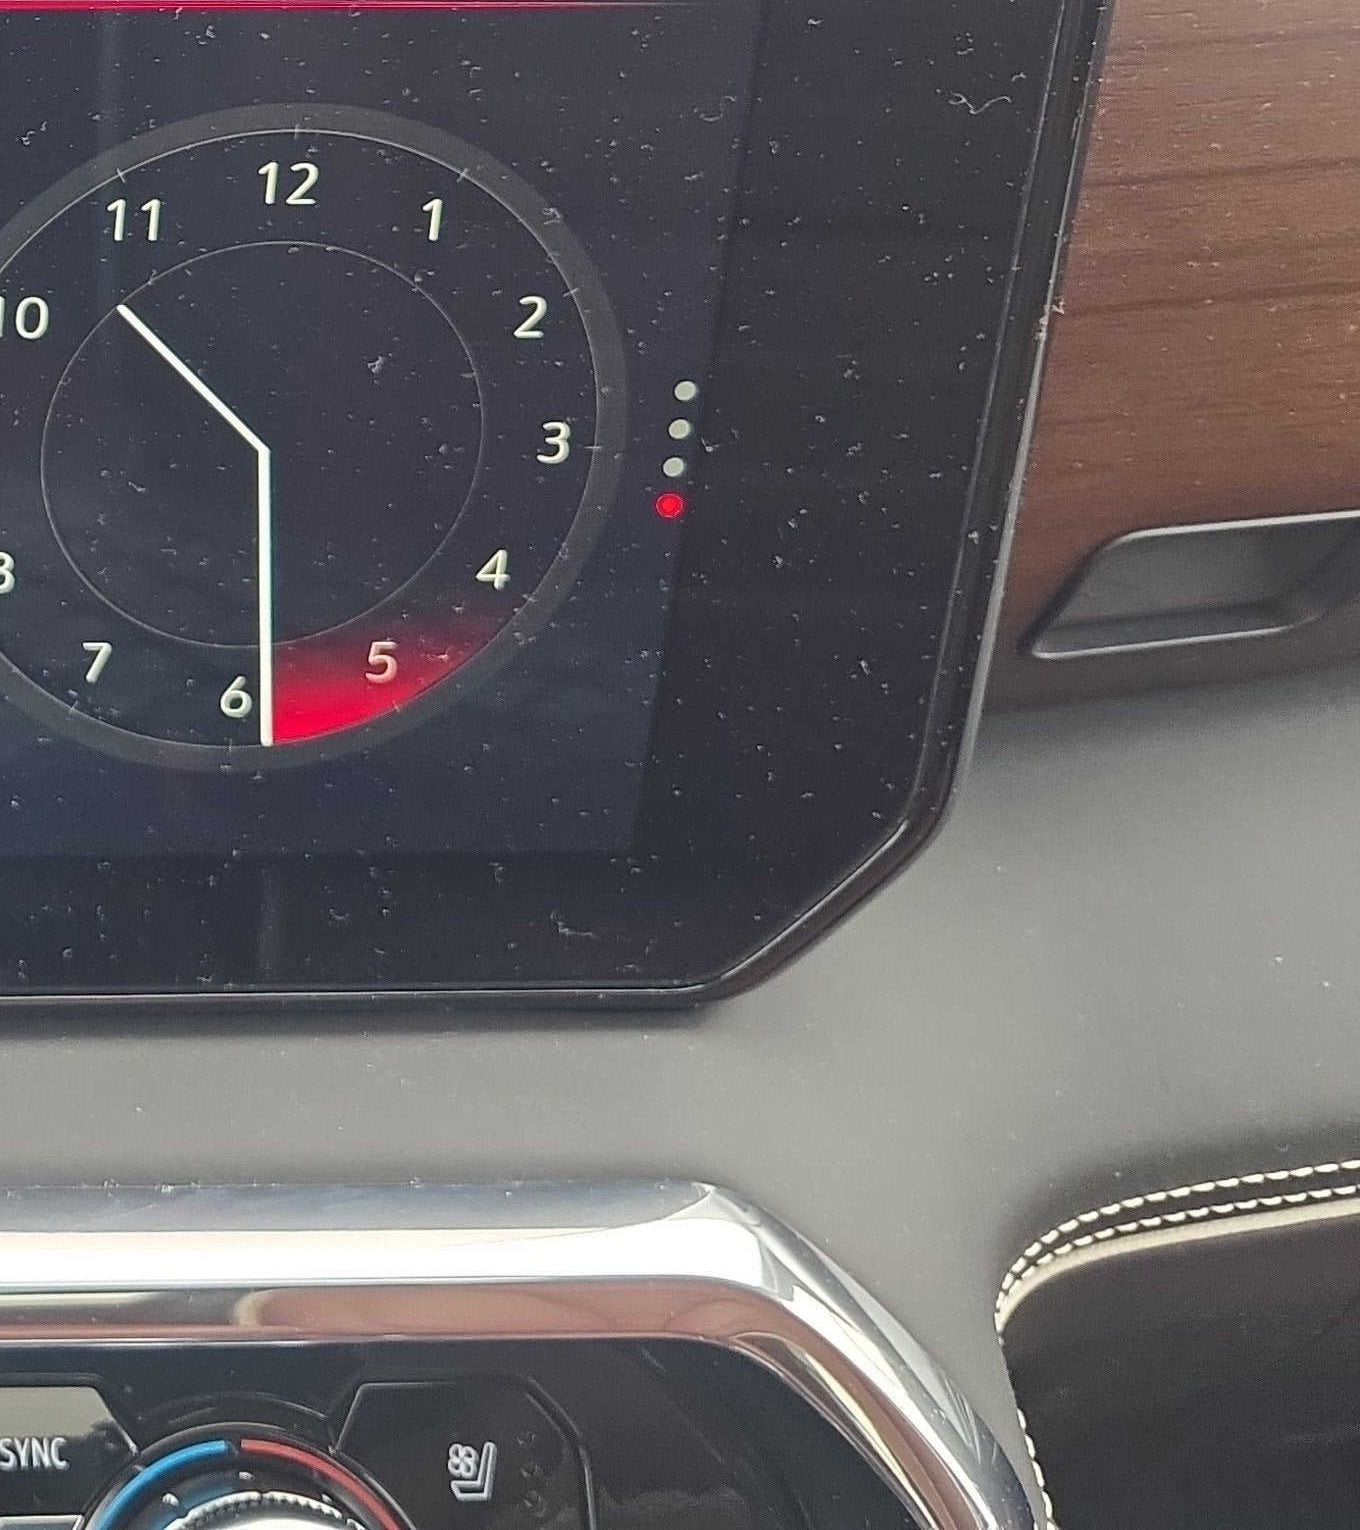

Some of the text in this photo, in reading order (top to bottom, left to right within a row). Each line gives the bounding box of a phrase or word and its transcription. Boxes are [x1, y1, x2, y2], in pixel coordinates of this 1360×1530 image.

[257, 160, 320, 206] 12
[106, 197, 162, 243] 11
[421, 197, 444, 242] 1
[512, 294, 548, 339] 2
[535, 420, 572, 465] 3
[474, 548, 511, 591] 4
[81, 641, 113, 684] 7
[364, 639, 398, 684] 5
[219, 675, 253, 719] 6
